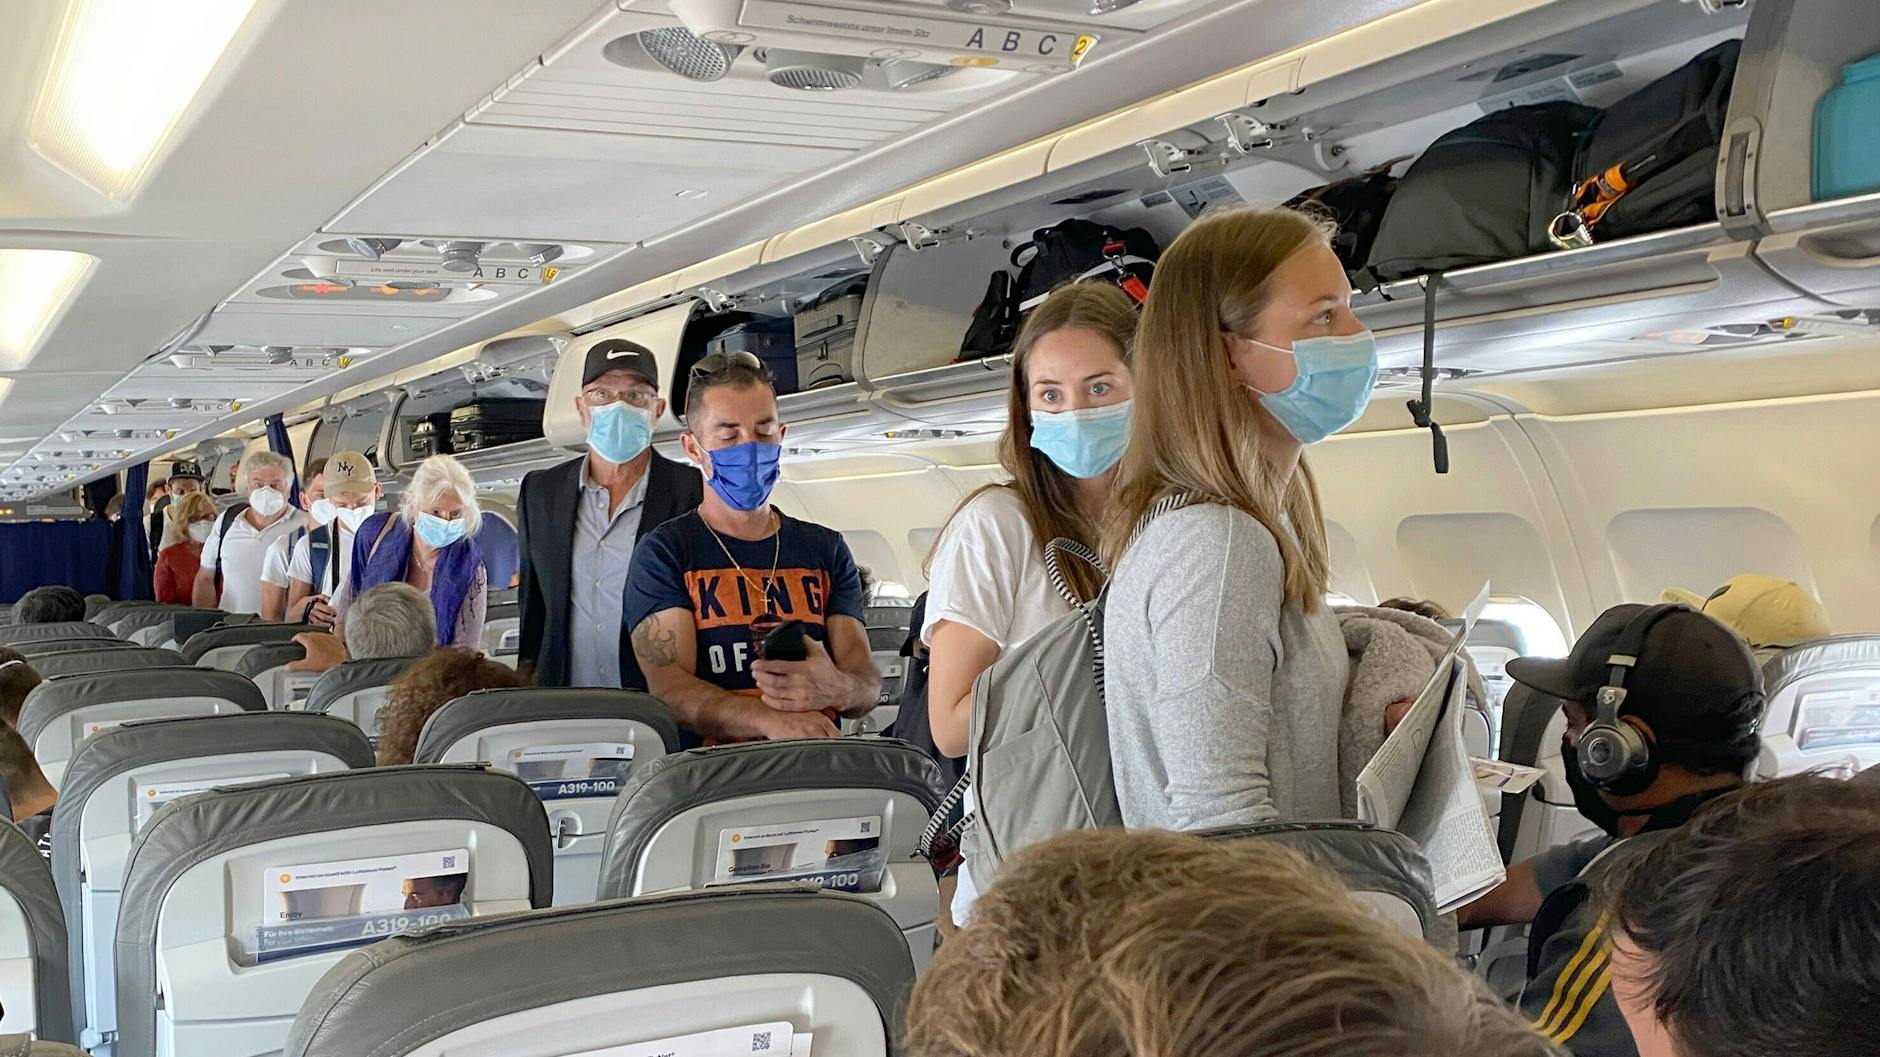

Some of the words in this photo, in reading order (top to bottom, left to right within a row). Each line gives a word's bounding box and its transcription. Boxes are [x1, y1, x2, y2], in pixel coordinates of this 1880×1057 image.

[913, 28, 931, 39] Sitz
[966, 27, 983, 48] A
[1002, 31, 1021, 51] B
[1038, 34, 1056, 55] C
[472, 266, 484, 278] A
[495, 267, 506, 279] B
[518, 268, 529, 279] C
[289, 358, 298, 367] A
[305, 358, 314, 367] B
[322, 358, 331, 366] C
[337, 461, 353, 476] NY
[697, 575, 824, 620] KING
[708, 642, 748, 674] OF
[558, 780, 615, 795] A319-100
[280, 911, 303, 919] Enjoy
